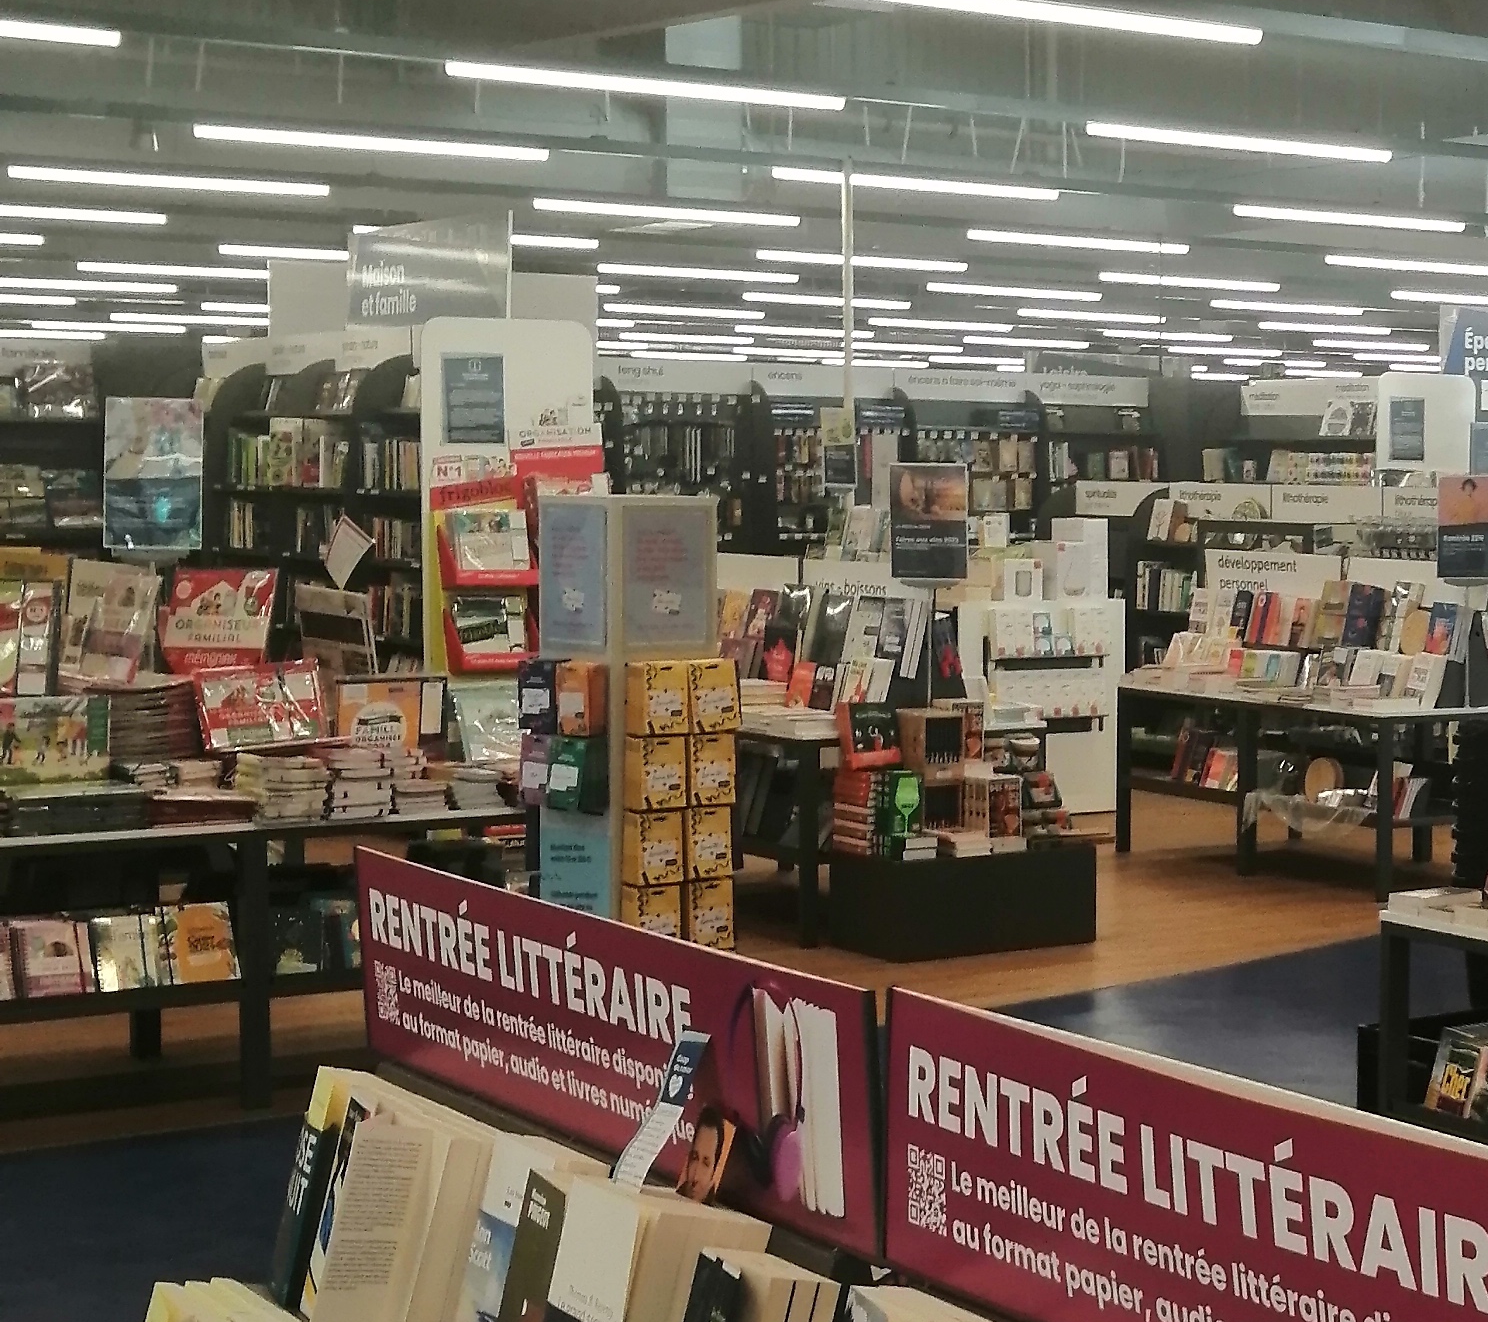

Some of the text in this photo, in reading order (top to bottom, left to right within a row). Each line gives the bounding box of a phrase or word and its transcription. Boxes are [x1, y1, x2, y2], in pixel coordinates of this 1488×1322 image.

[375, 288, 418, 315] famille
[1218, 556, 1298, 574] développement
[368, 887, 494, 982] RENTRÉE
[399, 970, 412, 996] Le
[412, 975, 462, 1015] meilleur
[463, 992, 481, 1021] de
[481, 998, 496, 1027] la
[497, 1009, 547, 1045] rentrée
[547, 1022, 611, 1070] littéraire
[402, 1010, 418, 1035] au
[418, 1012, 462, 1052] format
[462, 1035, 509, 1075] papier,
[509, 1053, 550, 1086] audio
[551, 1065, 567, 1093] et
[567, 1070, 608, 1113] livres
[908, 1044, 1128, 1195] RENTRÉE
[951, 1160, 974, 1196] Le
[976, 1174, 1067, 1233] meilleur
[1070, 1207, 1100, 1245] de
[1104, 1217, 1128, 1256] la
[1132, 1233, 1228, 1291] rentrée
[952, 1218, 980, 1252] au
[983, 1222, 1062, 1284] format
